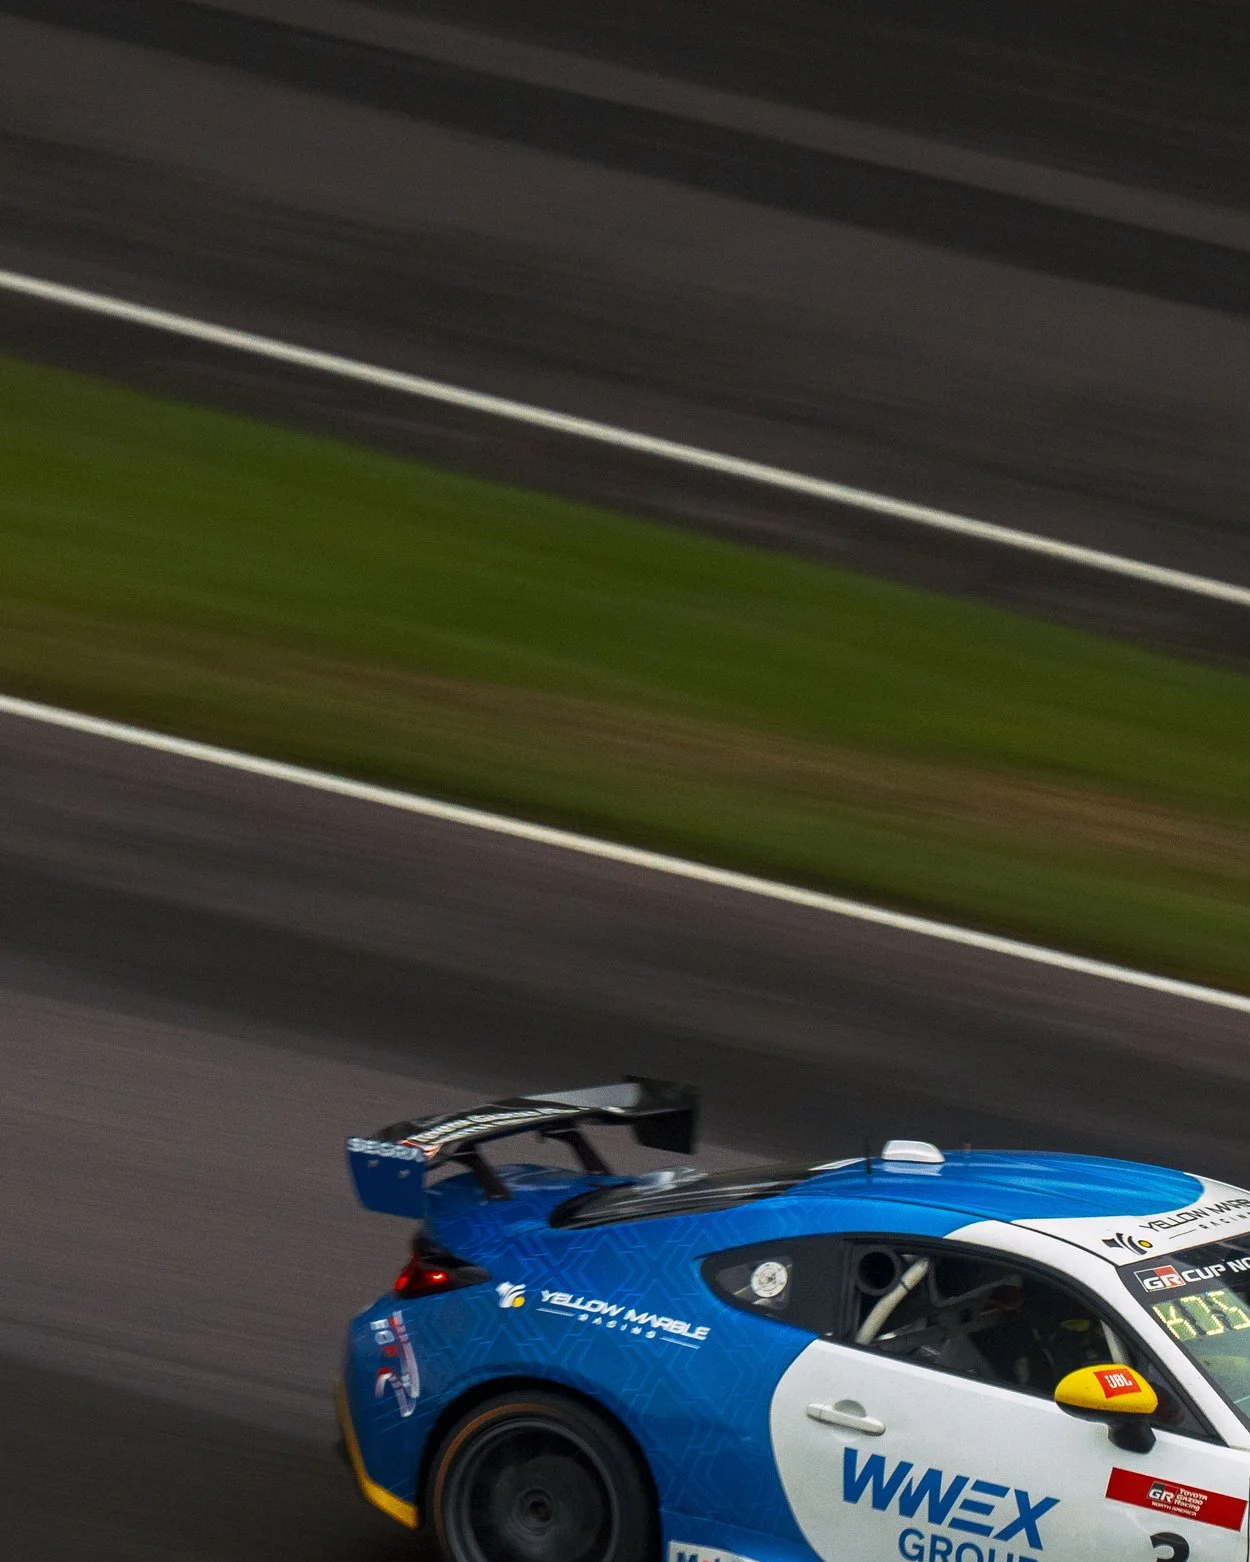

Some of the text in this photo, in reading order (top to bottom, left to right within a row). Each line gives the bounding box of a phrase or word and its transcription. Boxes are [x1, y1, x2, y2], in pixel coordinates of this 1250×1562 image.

[1138, 1208, 1210, 1232] YELLOW
[1142, 1273, 1182, 1291] GR
[1181, 1264, 1226, 1283] CUP
[541, 1289, 711, 1340] YELLOW MARBLE
[577, 1313, 657, 1339] RACING
[1104, 1373, 1133, 1389] JBL
[843, 1446, 1061, 1551] WWEX
[1148, 1488, 1208, 1503] GR TOYOTA
[1174, 1500, 1201, 1512] Racing
[1176, 1494, 1203, 1506] GAZOO
